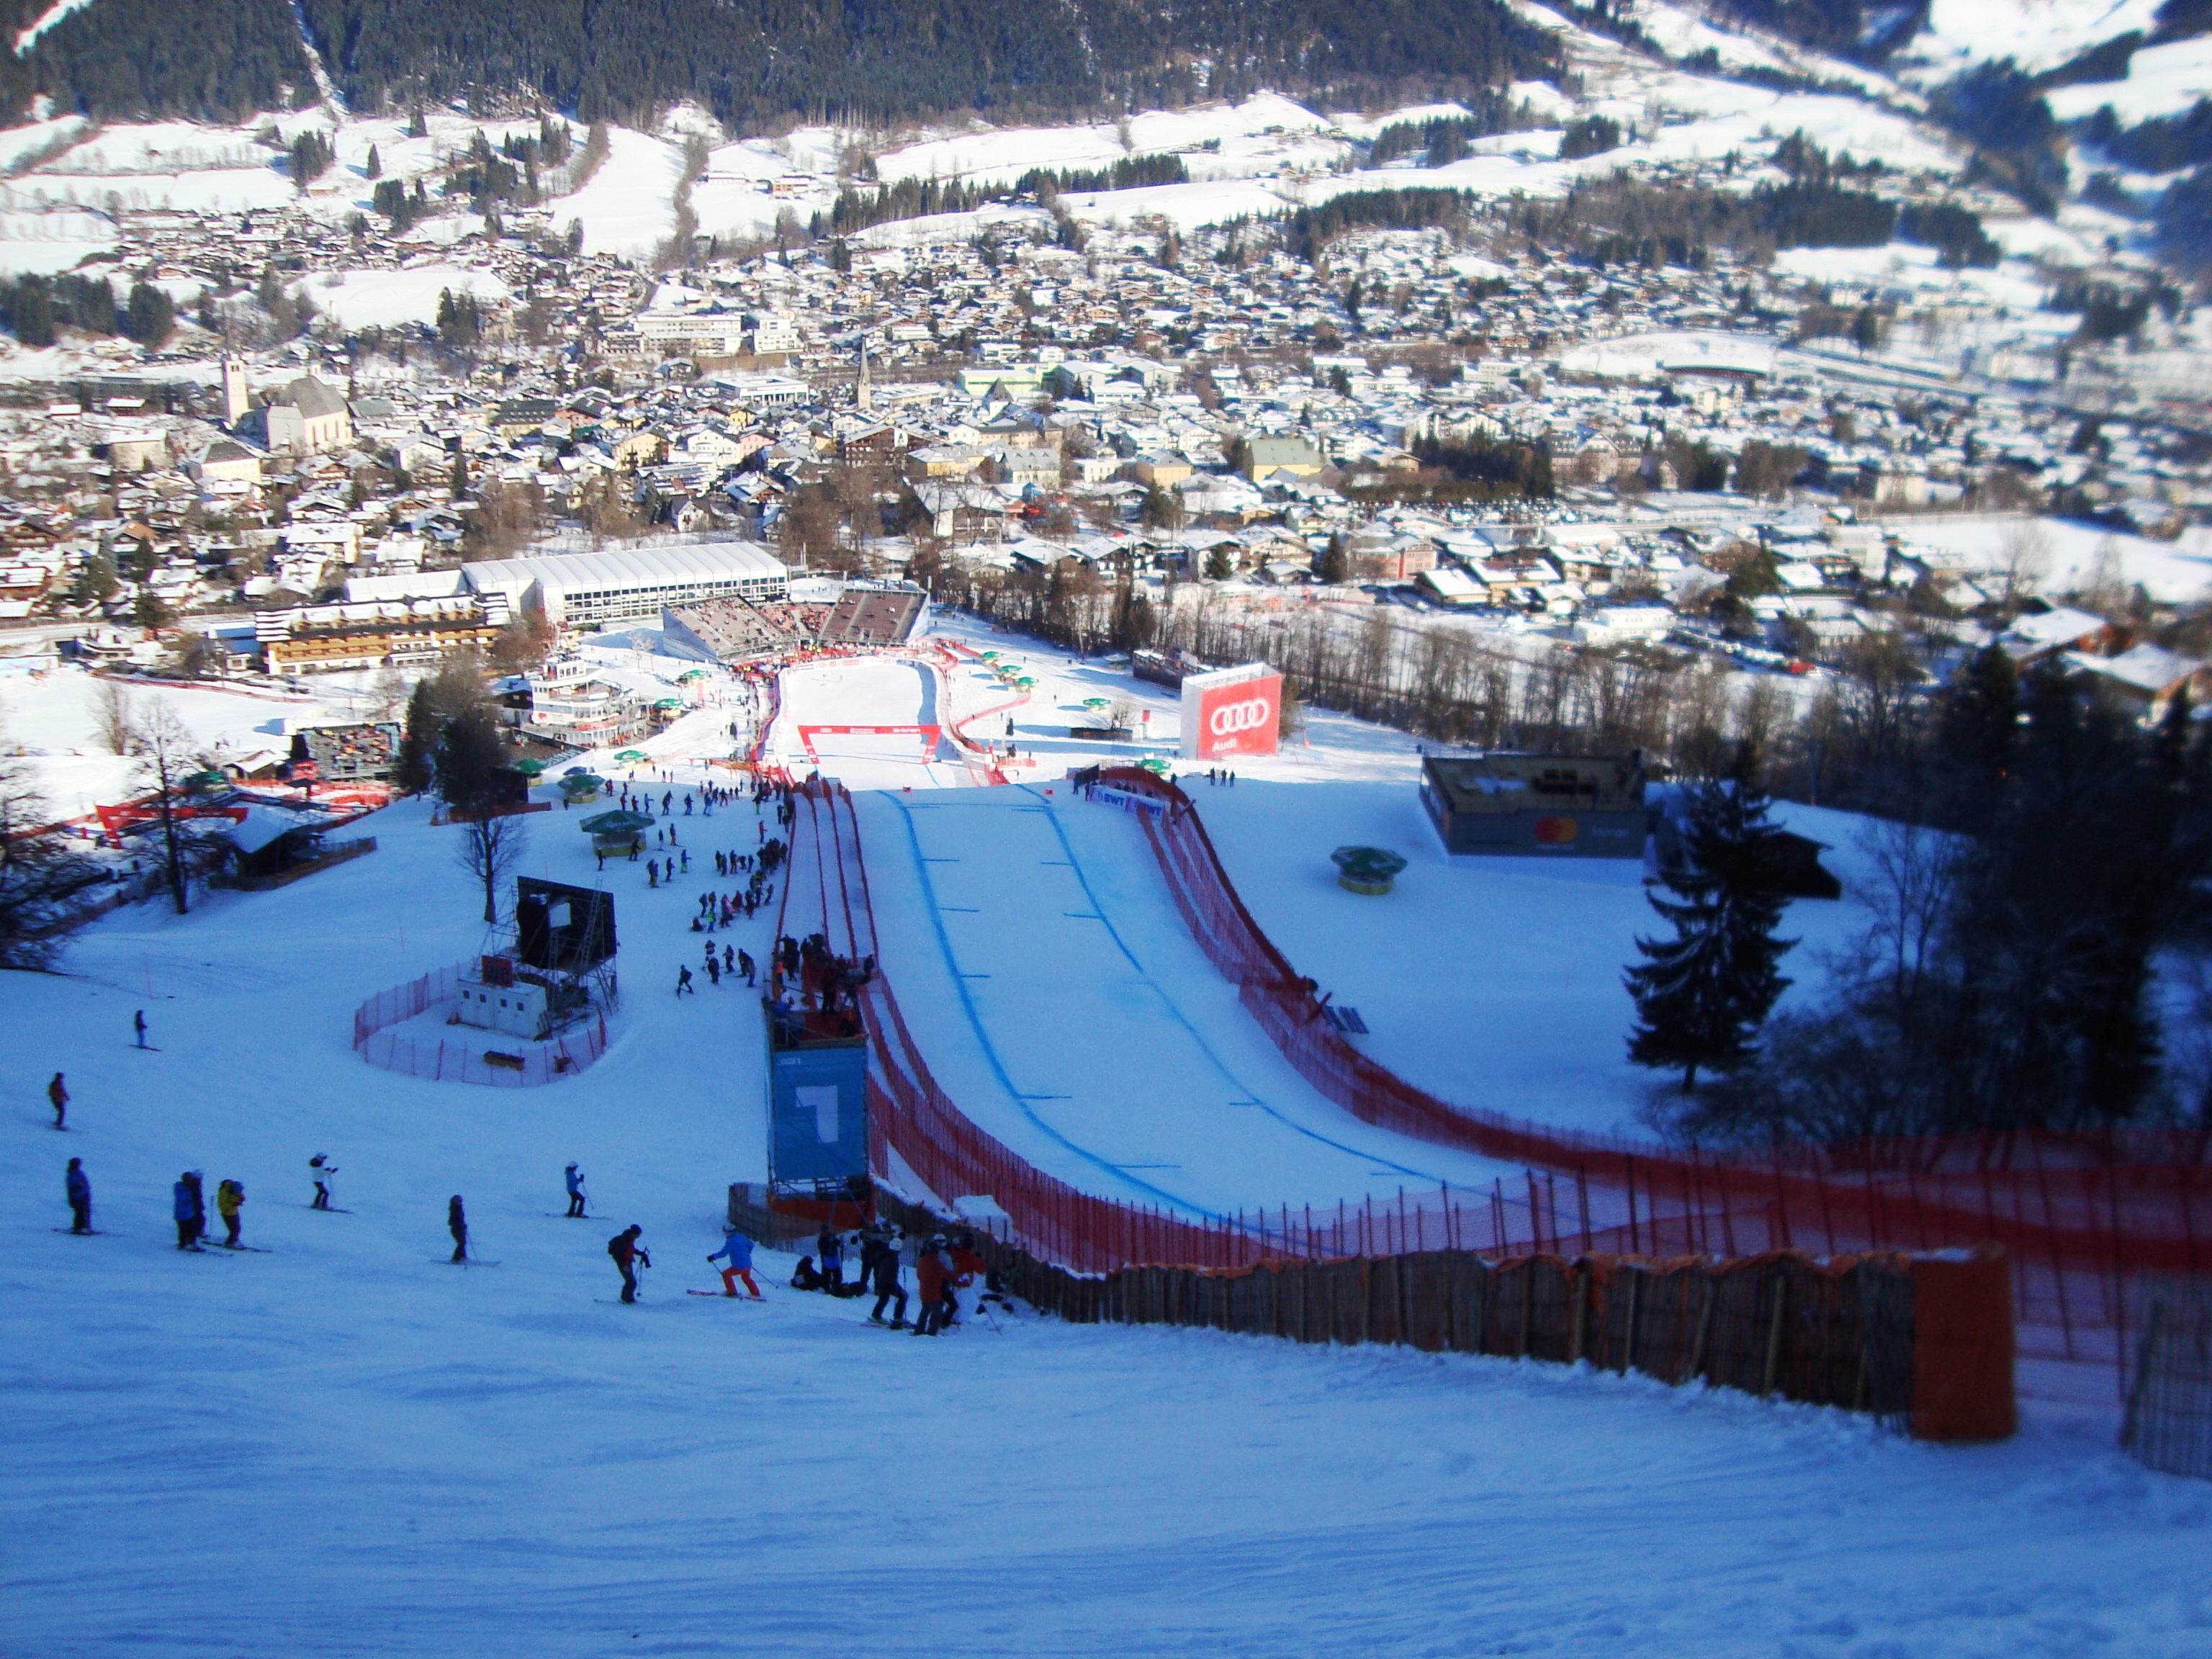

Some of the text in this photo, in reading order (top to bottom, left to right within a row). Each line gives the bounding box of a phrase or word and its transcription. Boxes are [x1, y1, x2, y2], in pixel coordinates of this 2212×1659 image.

[1212, 738, 1236, 752] Audi
[1104, 793, 1125, 806] BWT
[795, 1085, 839, 1143] 1
